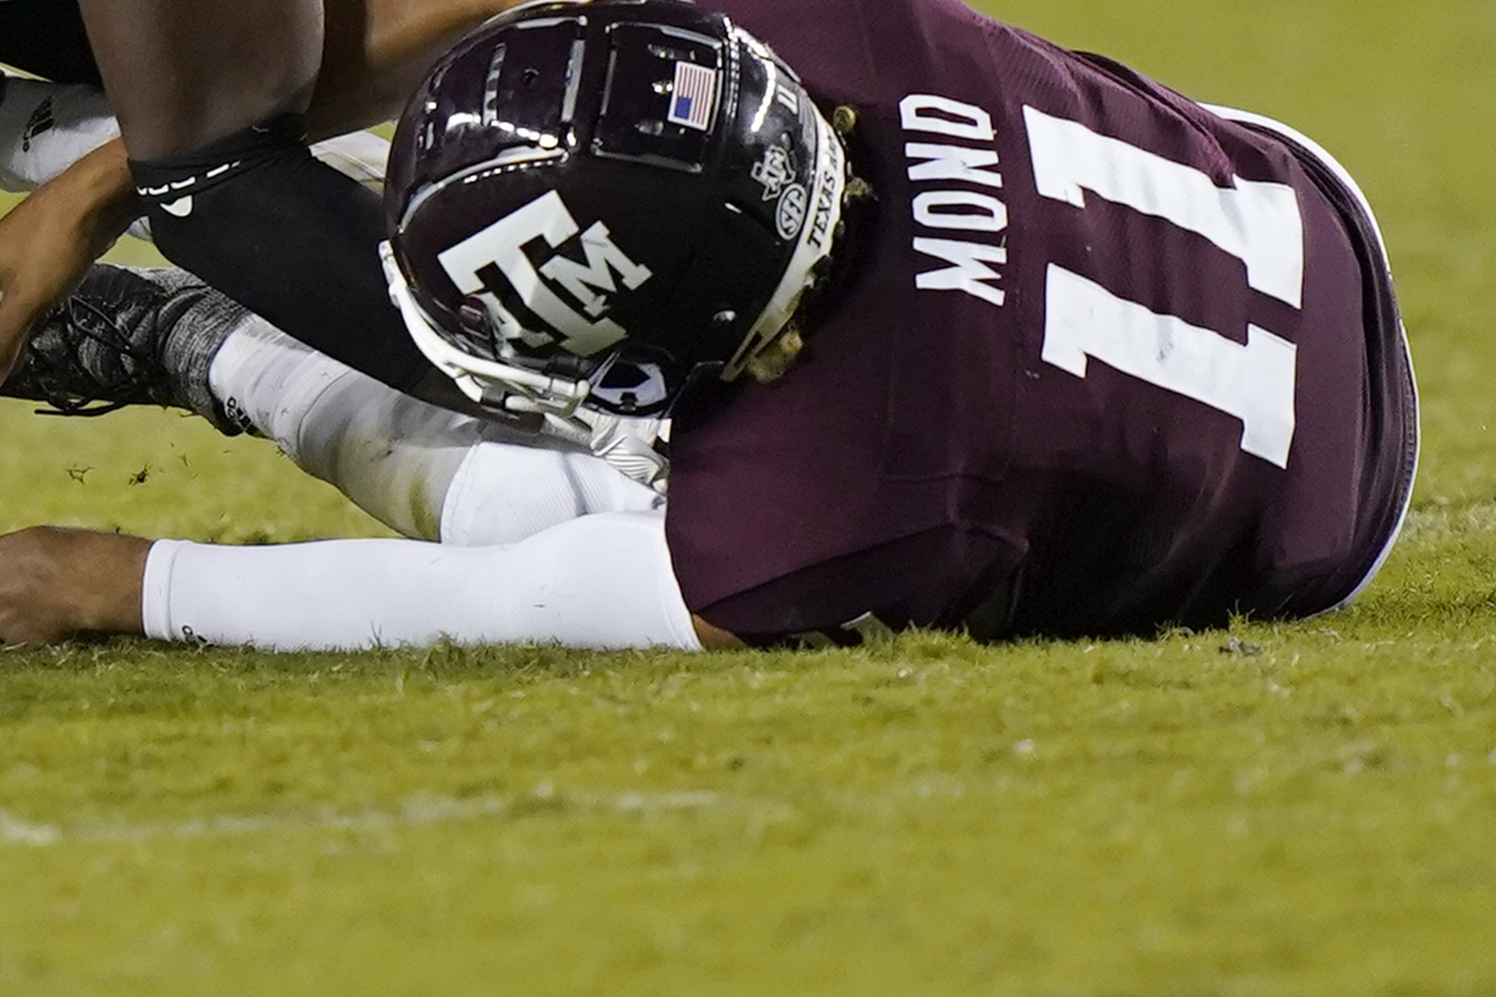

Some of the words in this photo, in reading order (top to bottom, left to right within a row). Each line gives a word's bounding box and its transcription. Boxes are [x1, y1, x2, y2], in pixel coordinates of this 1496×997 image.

[807, 170, 837, 248] TEXAS
[899, 93, 1008, 306] MOND
[1022, 104, 1304, 470] 11
